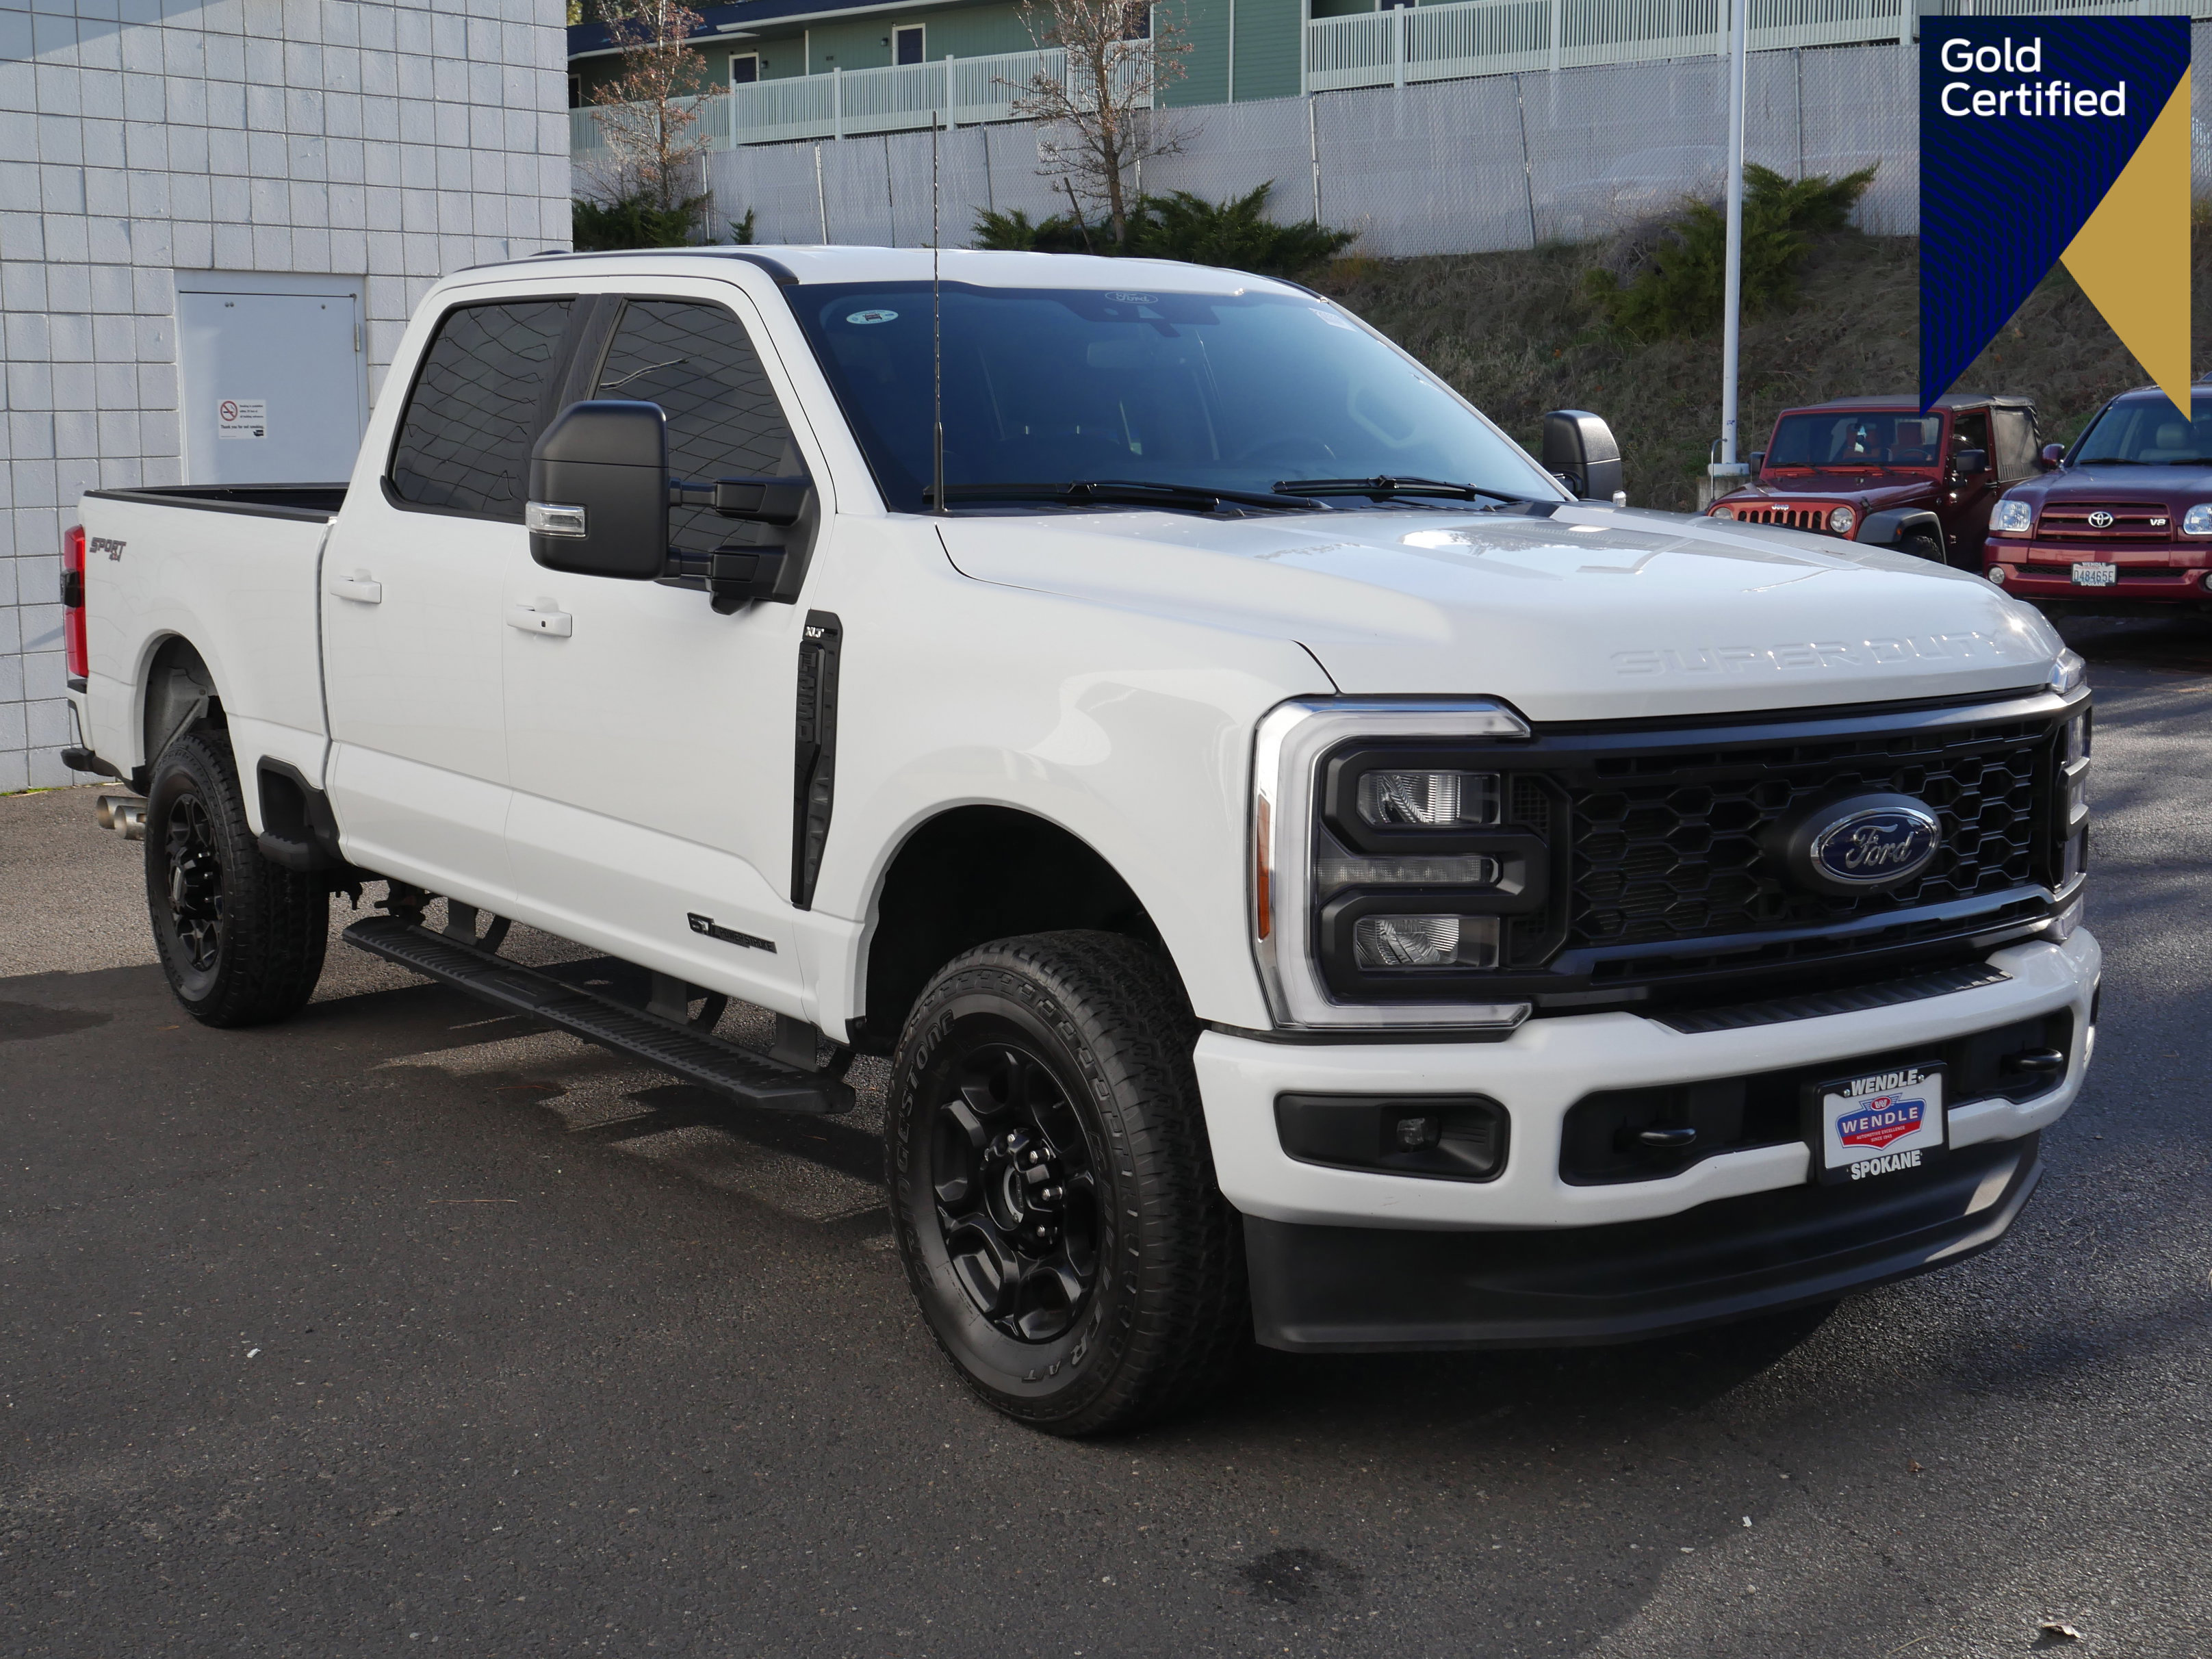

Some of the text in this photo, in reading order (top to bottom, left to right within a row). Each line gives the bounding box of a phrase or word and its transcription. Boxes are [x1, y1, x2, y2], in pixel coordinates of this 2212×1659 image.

[2074, 570, 2113, 582] D48465E
[1610, 642, 1862, 677] SUPER
[1845, 823, 1915, 869] Ford
[1851, 1069, 1918, 1096] WENDLE
[1842, 1107, 1918, 1133] WENDLE
[1851, 1150, 1921, 1181] SPOKANE
